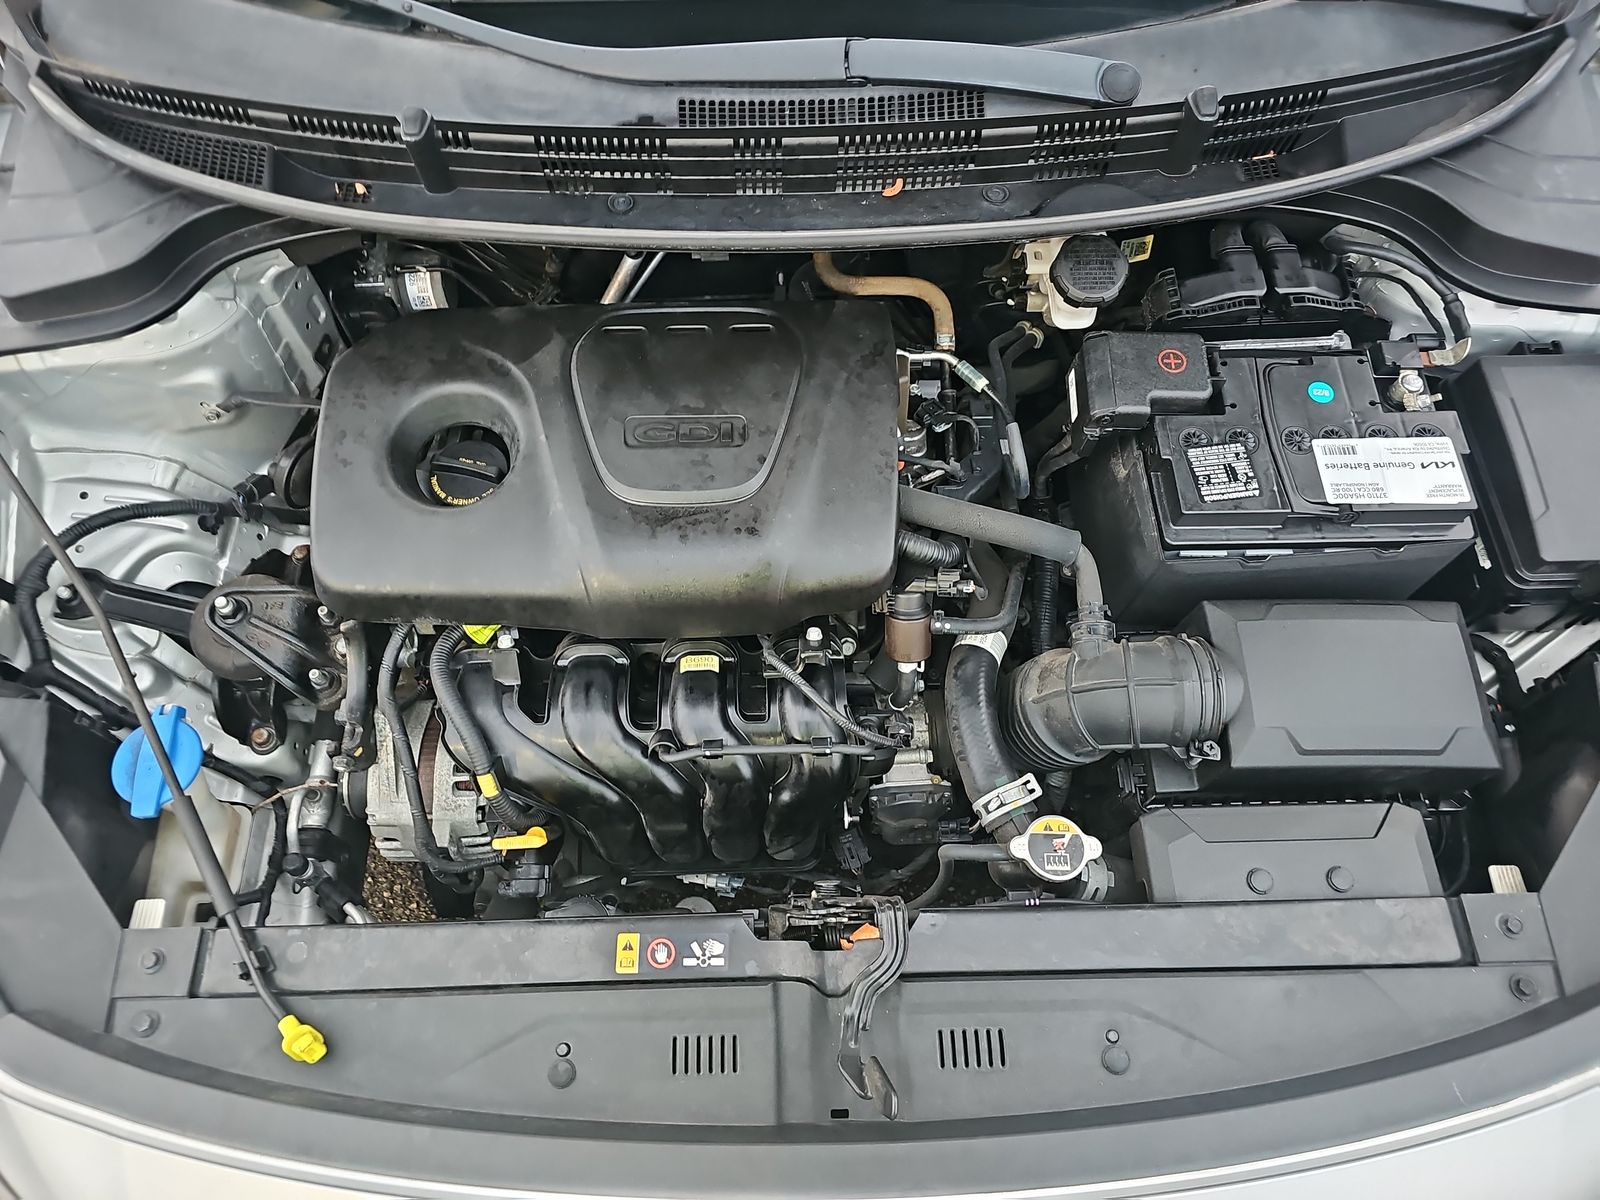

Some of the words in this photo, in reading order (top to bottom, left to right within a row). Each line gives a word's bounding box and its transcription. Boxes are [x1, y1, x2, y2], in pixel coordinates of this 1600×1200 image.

[633, 420, 734, 443] GDI
[1324, 462, 1371, 471] Batteries
[1372, 461, 1416, 470] Genuine
[430, 474, 447, 499] MANUAL
[446, 495, 480, 506] OWNER'S
